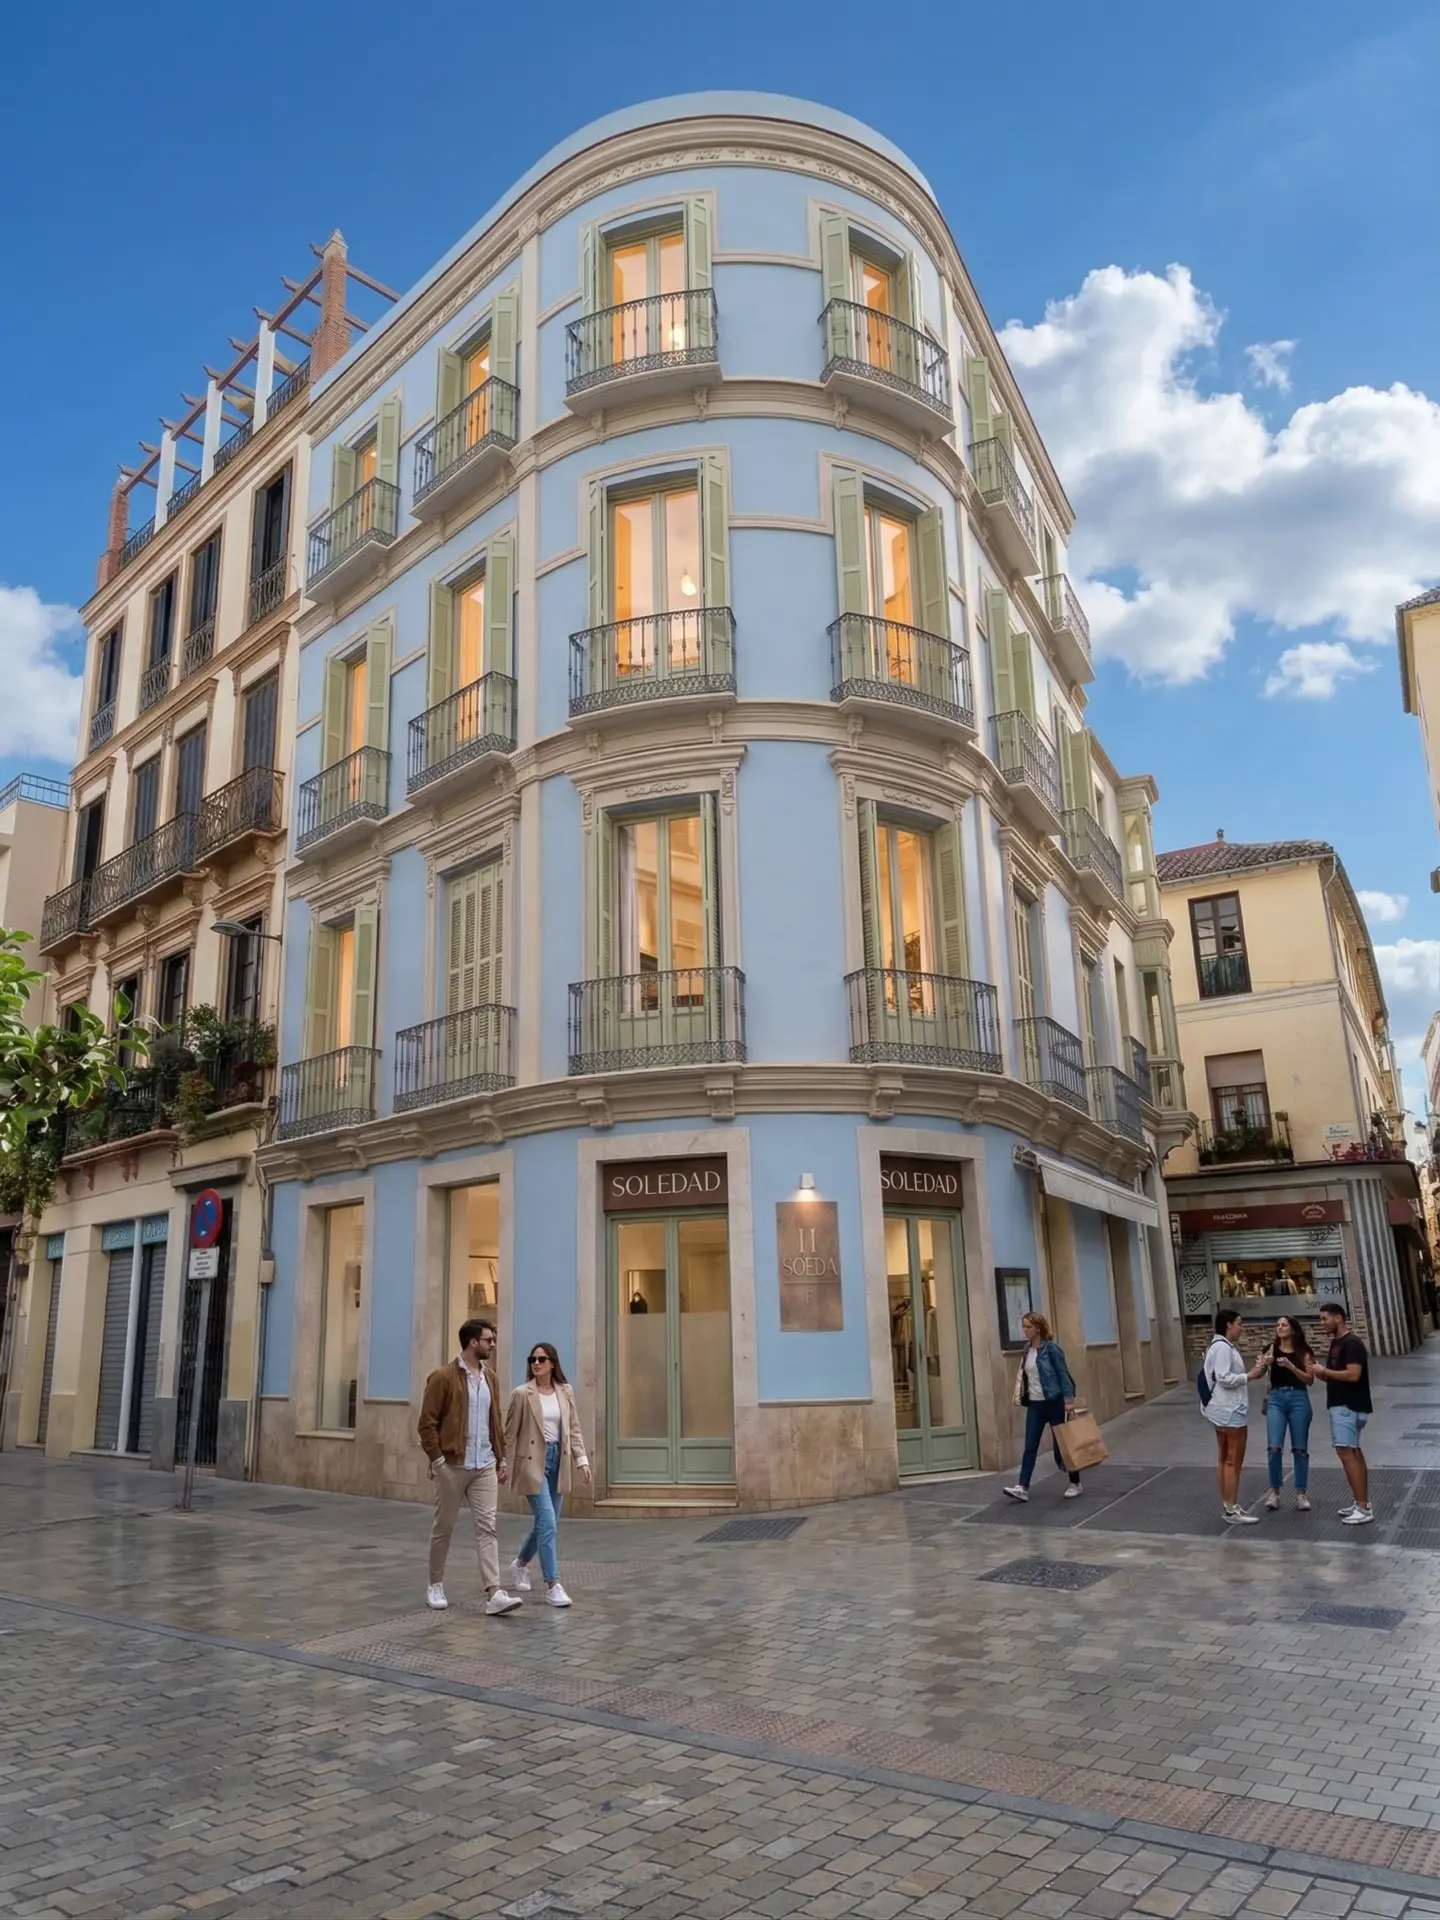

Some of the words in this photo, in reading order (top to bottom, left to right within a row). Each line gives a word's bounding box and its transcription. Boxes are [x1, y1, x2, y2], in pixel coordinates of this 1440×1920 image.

[611, 1170, 721, 1198] SOLEDAD
[879, 1169, 958, 1194] SOLEDAD
[782, 1257, 838, 1277] SOEDA
